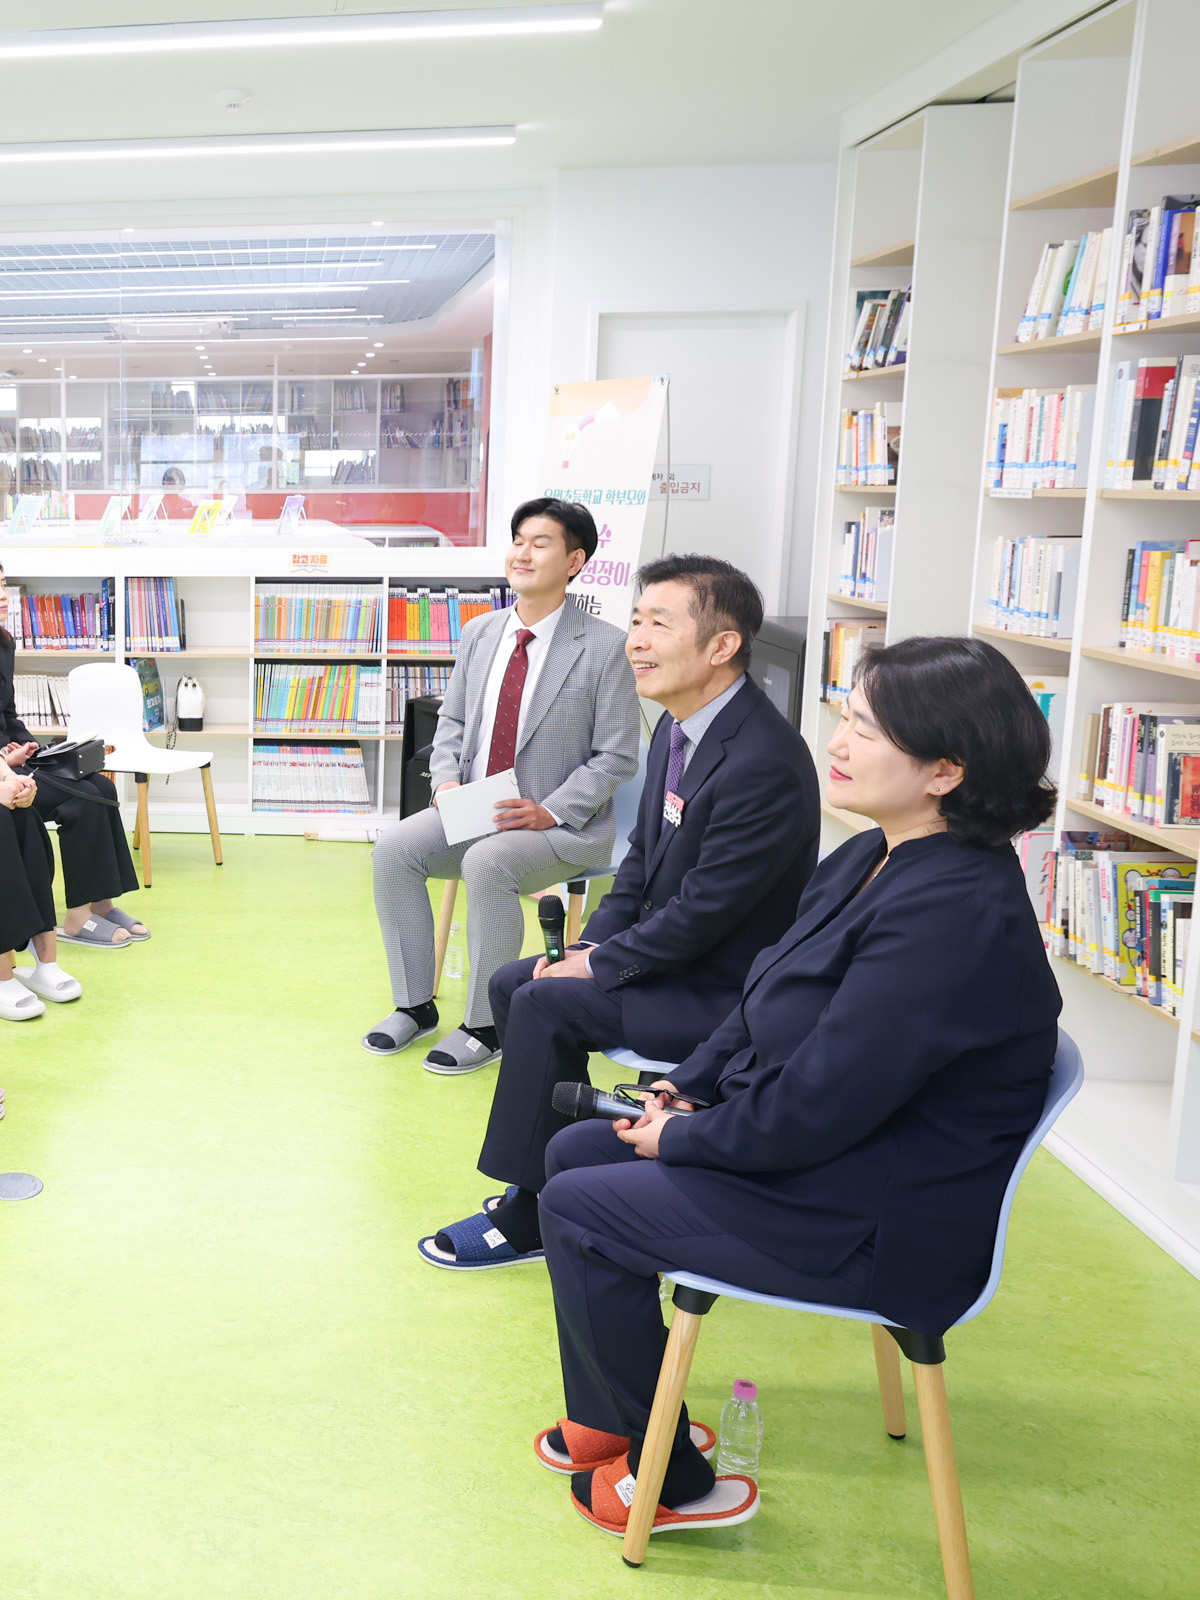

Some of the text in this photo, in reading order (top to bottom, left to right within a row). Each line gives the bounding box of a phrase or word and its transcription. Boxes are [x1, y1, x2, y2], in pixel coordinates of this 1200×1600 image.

[660, 481, 701, 494] 출입금지
[606, 489, 647, 505] 학부모와
[291, 554, 328, 564] 참고 자료
